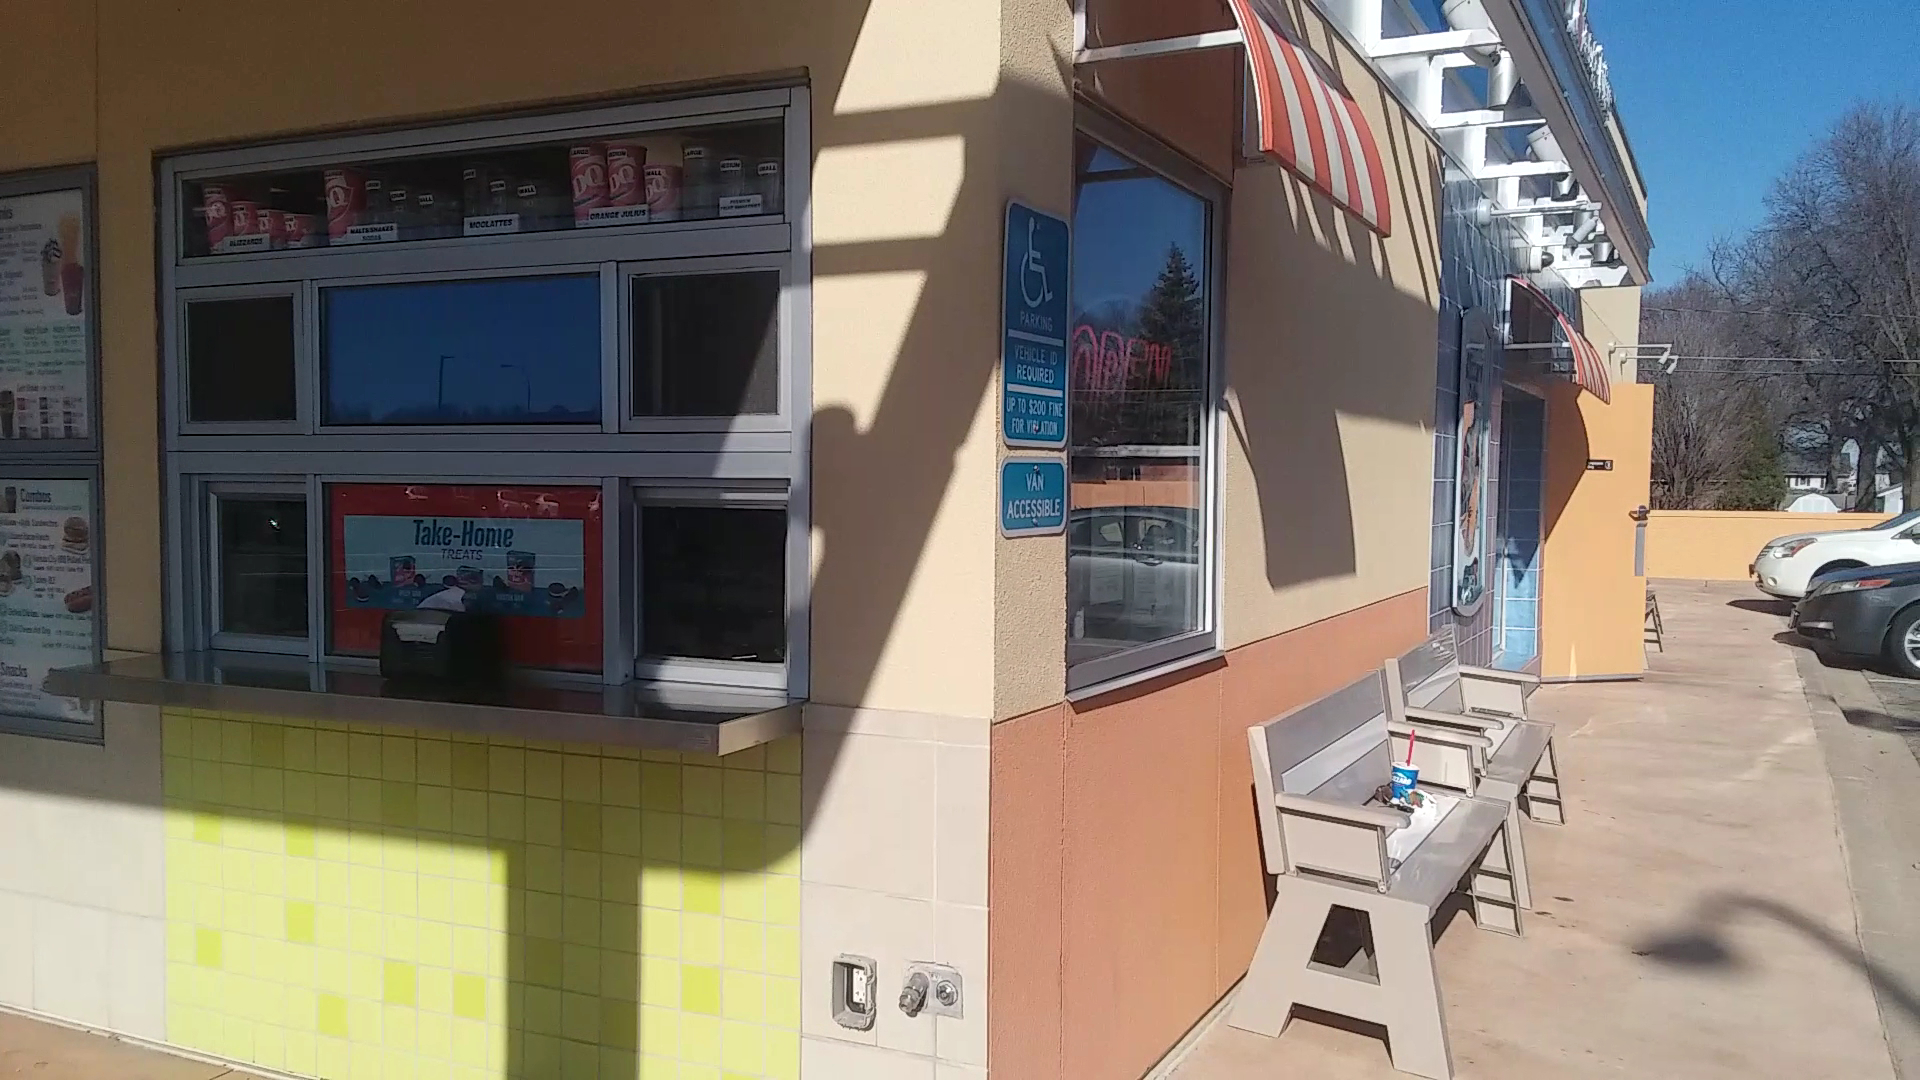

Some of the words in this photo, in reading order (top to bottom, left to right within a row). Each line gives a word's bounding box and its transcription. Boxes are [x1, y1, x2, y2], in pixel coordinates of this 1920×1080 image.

[590, 211, 619, 220] ORANGE
[621, 209, 646, 218] JULIUS
[1020, 310, 1053, 332] PARKING
[1014, 345, 1046, 363] VEHICLE
[1050, 351, 1058, 366] ID
[1016, 364, 1055, 384] REQUIRED
[1006, 397, 1016, 413] UP
[1017, 398, 1027, 414] TO
[1028, 399, 1046, 416] $200
[1048, 402, 1063, 417] FINE
[1011, 418, 1025, 433] FOR
[1026, 419, 1058, 436] VIOLATION
[1025, 473, 1044, 492] VAN
[1006, 499, 1061, 519] ACCESSIBLE
[413, 519, 515, 548] Take-Home
[441, 548, 483, 561] TREATS
